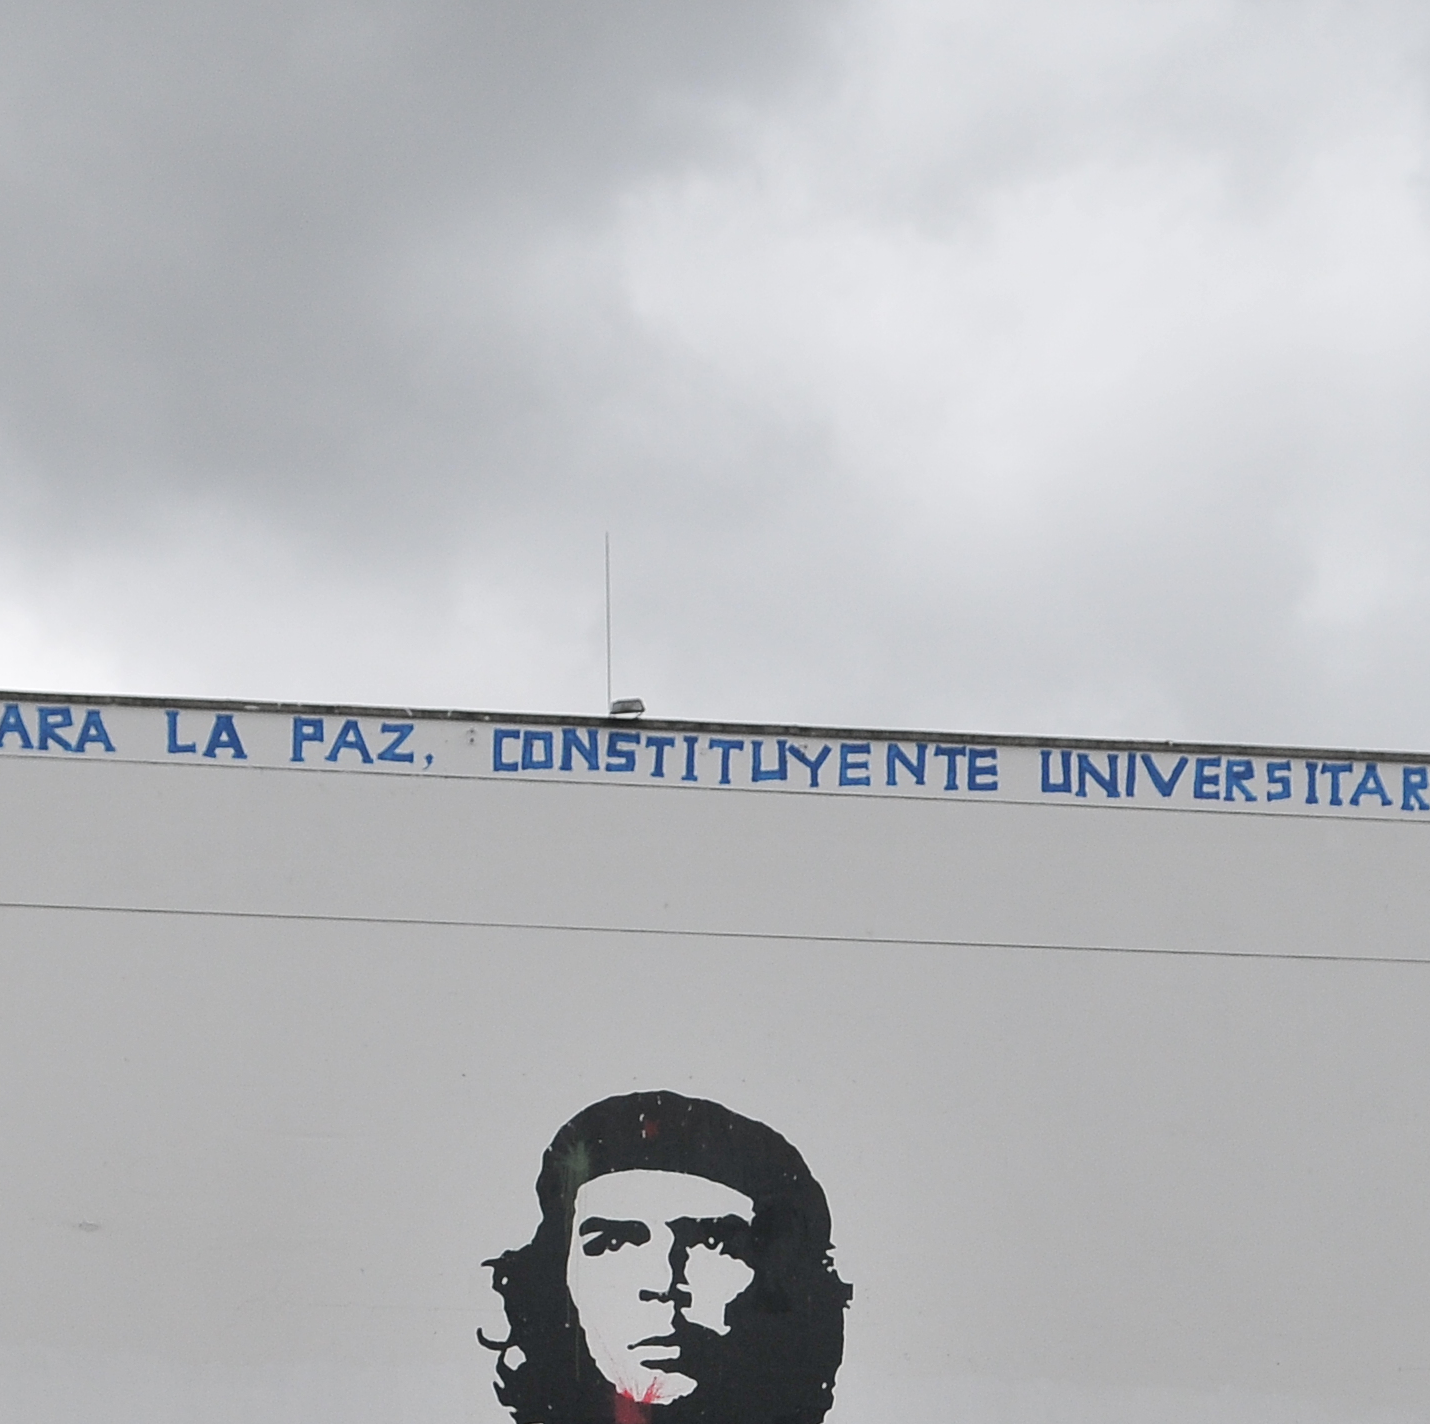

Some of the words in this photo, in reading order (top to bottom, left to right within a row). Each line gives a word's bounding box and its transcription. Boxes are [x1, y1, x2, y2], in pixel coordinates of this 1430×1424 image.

[165, 710, 248, 760] LA
[290, 716, 434, 770] PAZ,
[492, 728, 999, 792] CONSTITUYENTE
